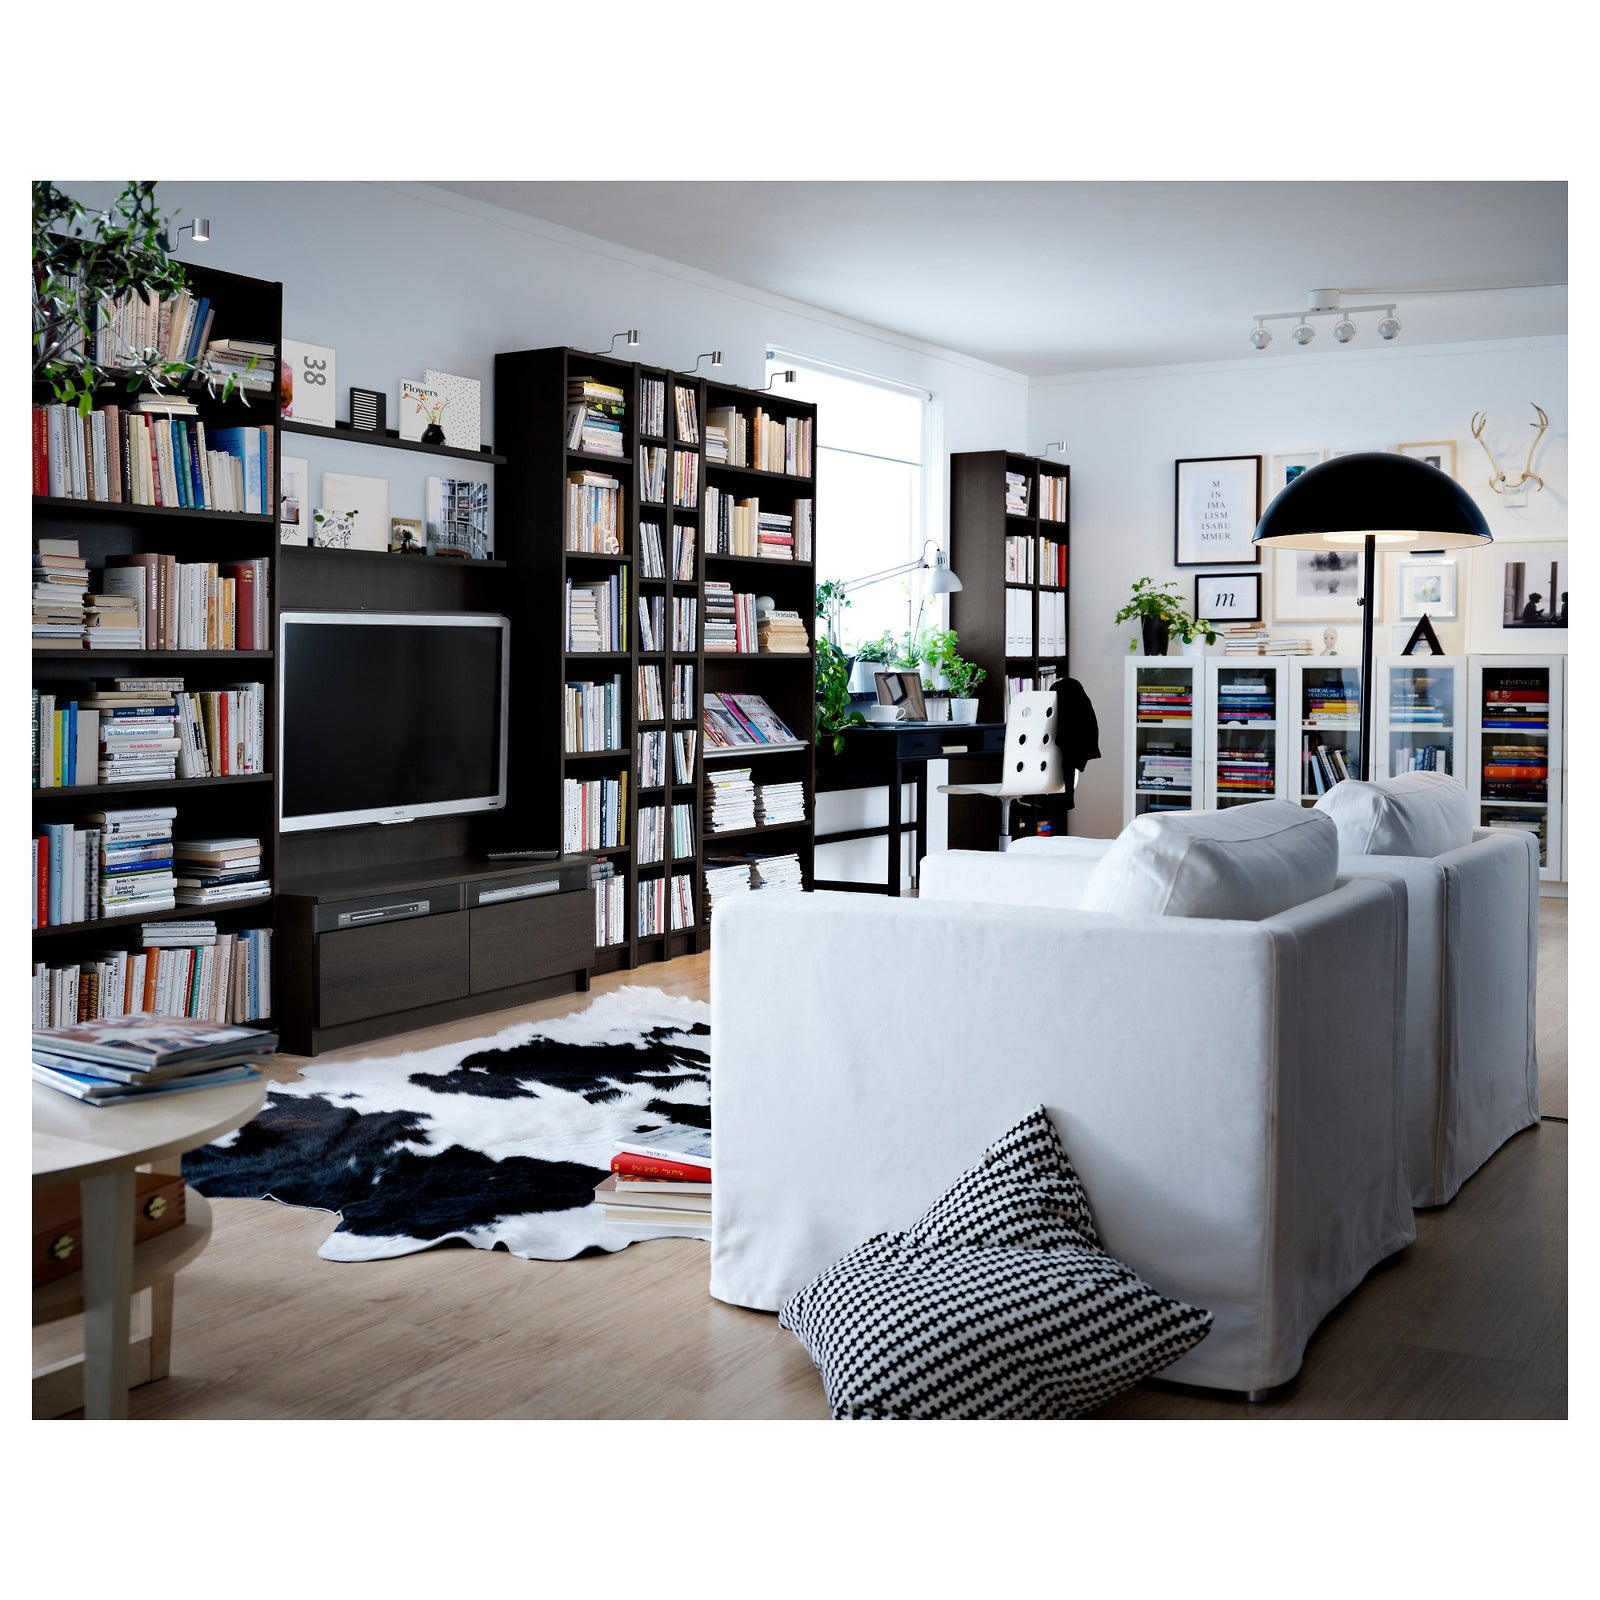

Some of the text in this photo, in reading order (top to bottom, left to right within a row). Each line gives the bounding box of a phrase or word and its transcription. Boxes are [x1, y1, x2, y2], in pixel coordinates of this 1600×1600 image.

[304, 355, 327, 386] 38
[403, 383, 438, 397] Flowers
[1212, 480, 1220, 488] M
[1211, 491, 1222, 499] IN
[1207, 501, 1226, 509] IMA
[1204, 512, 1228, 520] LISM
[1201, 522, 1231, 530] ISABU
[1400, 612, 1445, 656] A
